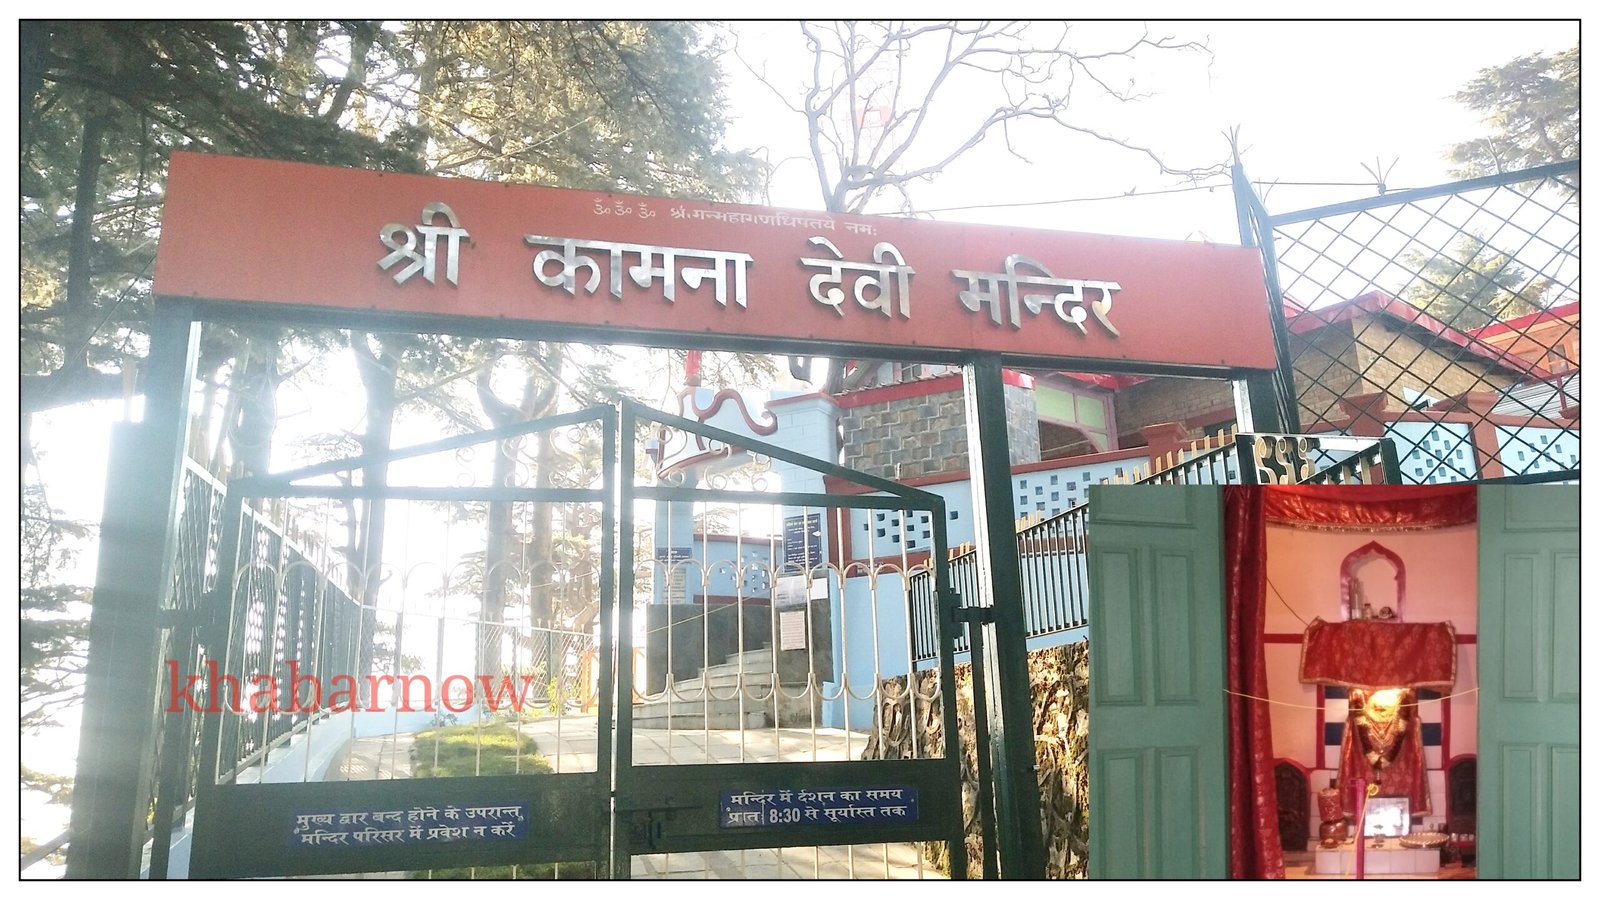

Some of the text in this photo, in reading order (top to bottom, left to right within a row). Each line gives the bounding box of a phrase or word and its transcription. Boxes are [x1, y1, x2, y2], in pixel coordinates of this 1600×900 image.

[593, 197, 611, 215] ॐ
[614, 199, 632, 216] ॐ
[638, 202, 656, 219] ॐ
[375, 201, 1122, 337] श्री कामना देवी मन्दिर
[730, 790, 777, 806] मन्दिर
[779, 789, 793, 804] में
[840, 790, 862, 802] का
[865, 789, 903, 802] समय
[296, 813, 335, 830] मुख्य
[339, 812, 369, 825] द्वार
[372, 810, 404, 823] बन्द
[407, 806, 440, 823] होने
[444, 805, 461, 820] के
[769, 807, 801, 824] 8:30
[804, 805, 820, 820] से
[823, 804, 877, 823] सूर्यास्त
[879, 805, 907, 817] तक
[301, 821, 516, 845] मन्दिर परिसर में प्रवेश न करें
